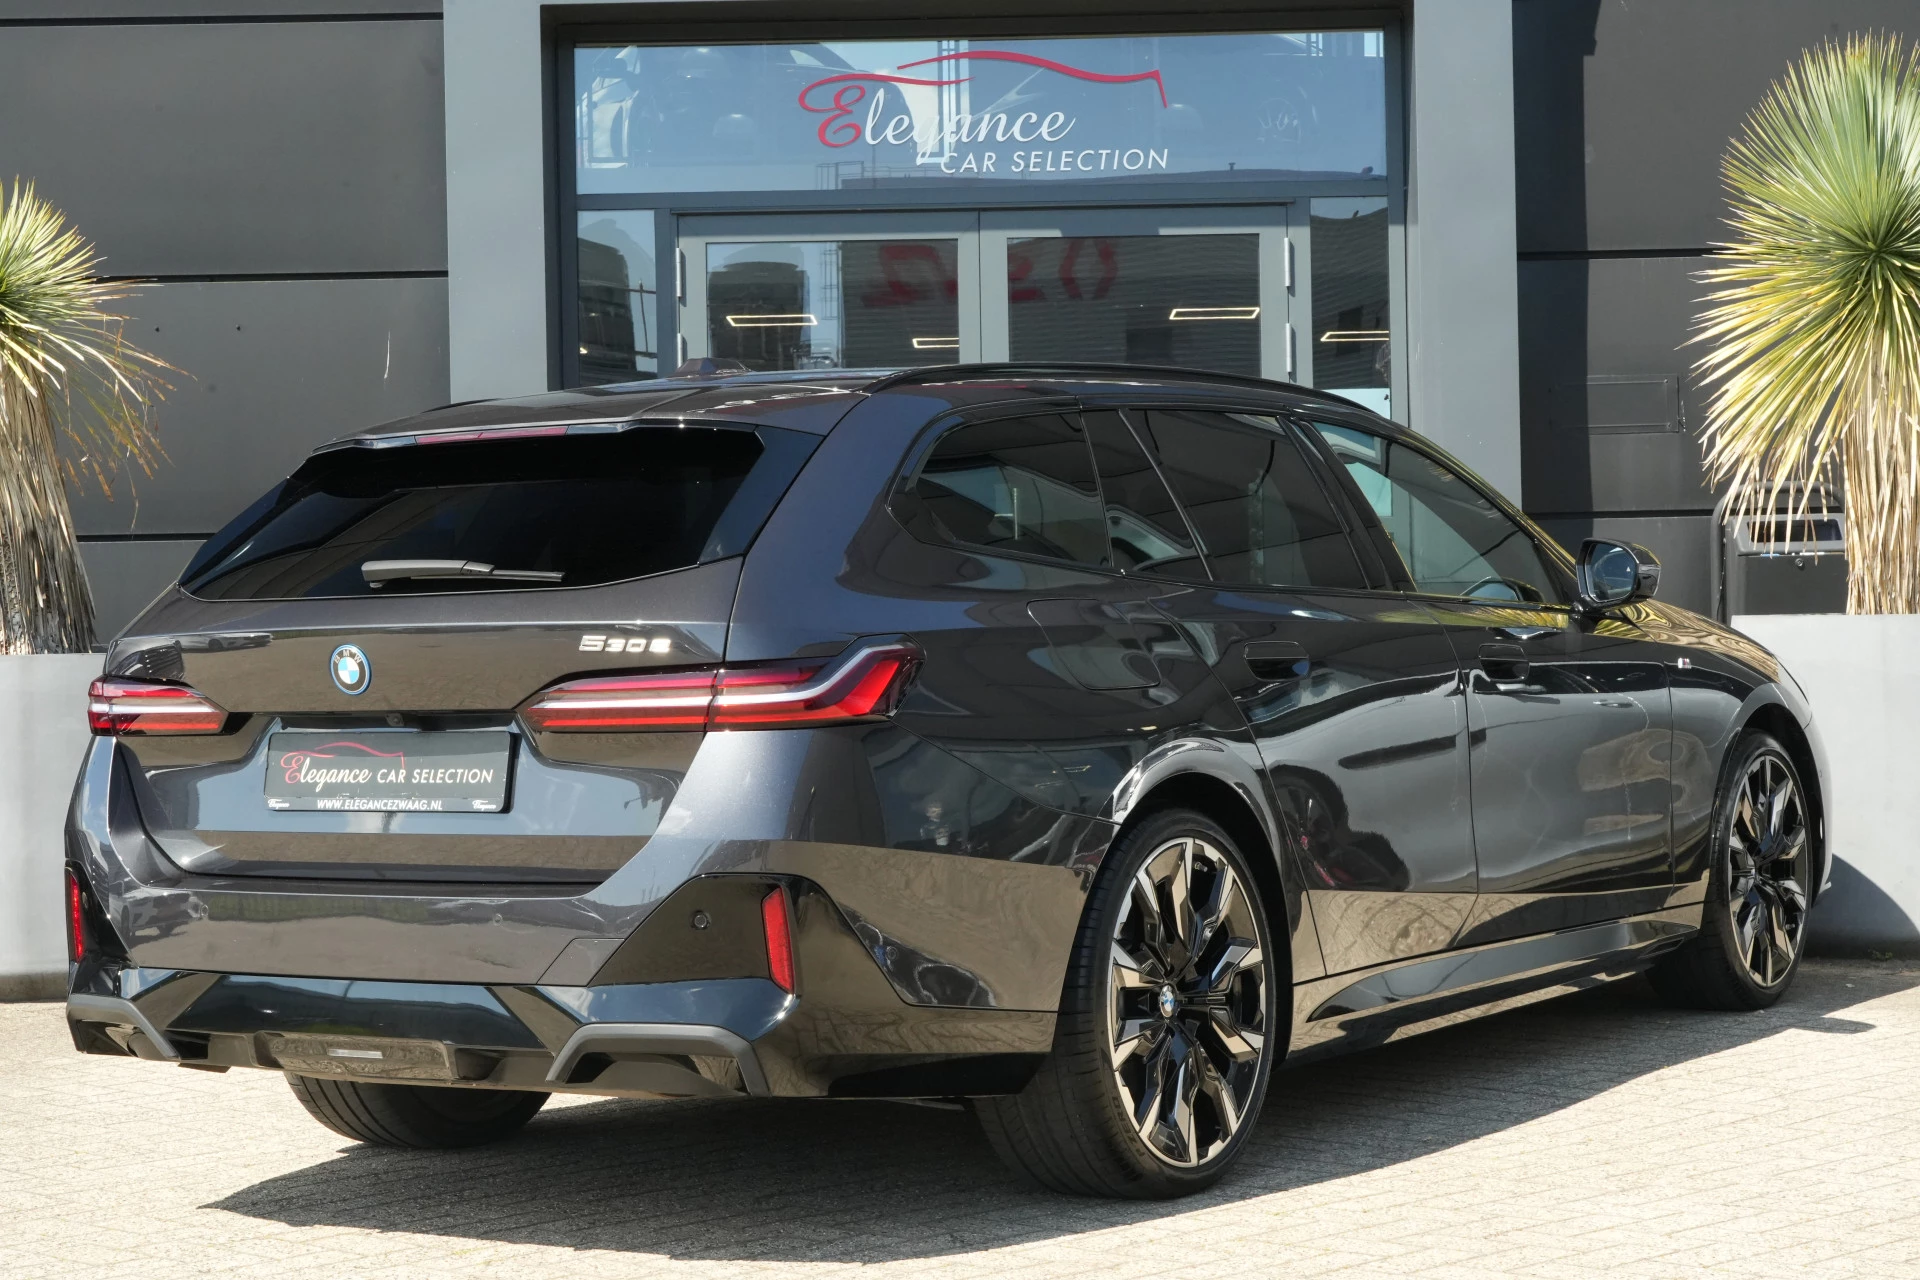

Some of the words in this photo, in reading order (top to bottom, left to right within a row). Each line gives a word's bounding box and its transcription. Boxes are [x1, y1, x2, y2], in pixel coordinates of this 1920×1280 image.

[798, 73, 1076, 166] Elegance
[940, 151, 996, 174] CAR
[1011, 148, 1169, 173] SELECTION
[334, 649, 362, 664] BMW
[280, 750, 373, 792] Elegance
[377, 768, 406, 784] CAR
[411, 768, 493, 784] SELECTION
[317, 799, 443, 811] WWW.ELEGANCEZWAAG.NL
